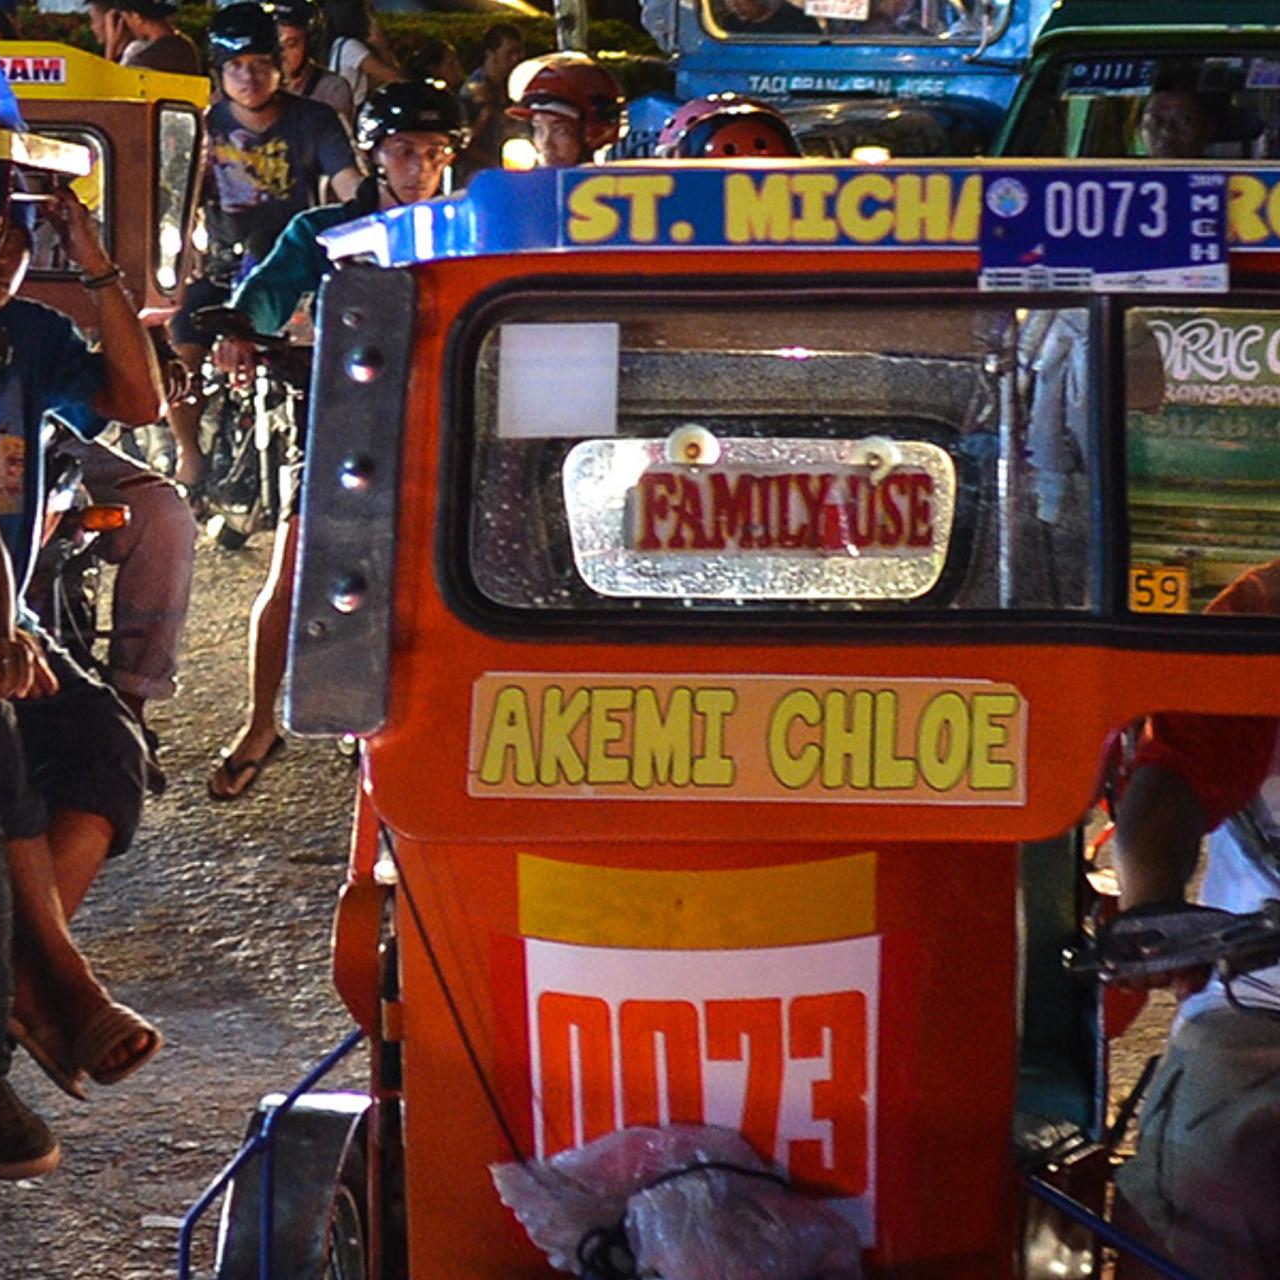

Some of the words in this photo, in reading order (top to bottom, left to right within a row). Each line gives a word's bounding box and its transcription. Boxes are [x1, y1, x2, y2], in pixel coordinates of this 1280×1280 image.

[566, 175, 694, 244] ST.
[1044, 180, 1168, 239] 0073
[634, 471, 836, 552] FAMILY
[844, 472, 935, 552] USE
[1134, 573, 1180, 609] 59
[478, 685, 738, 790] AKEMI
[767, 687, 1019, 791] CHLOE
[537, 988, 869, 1199] 0073
